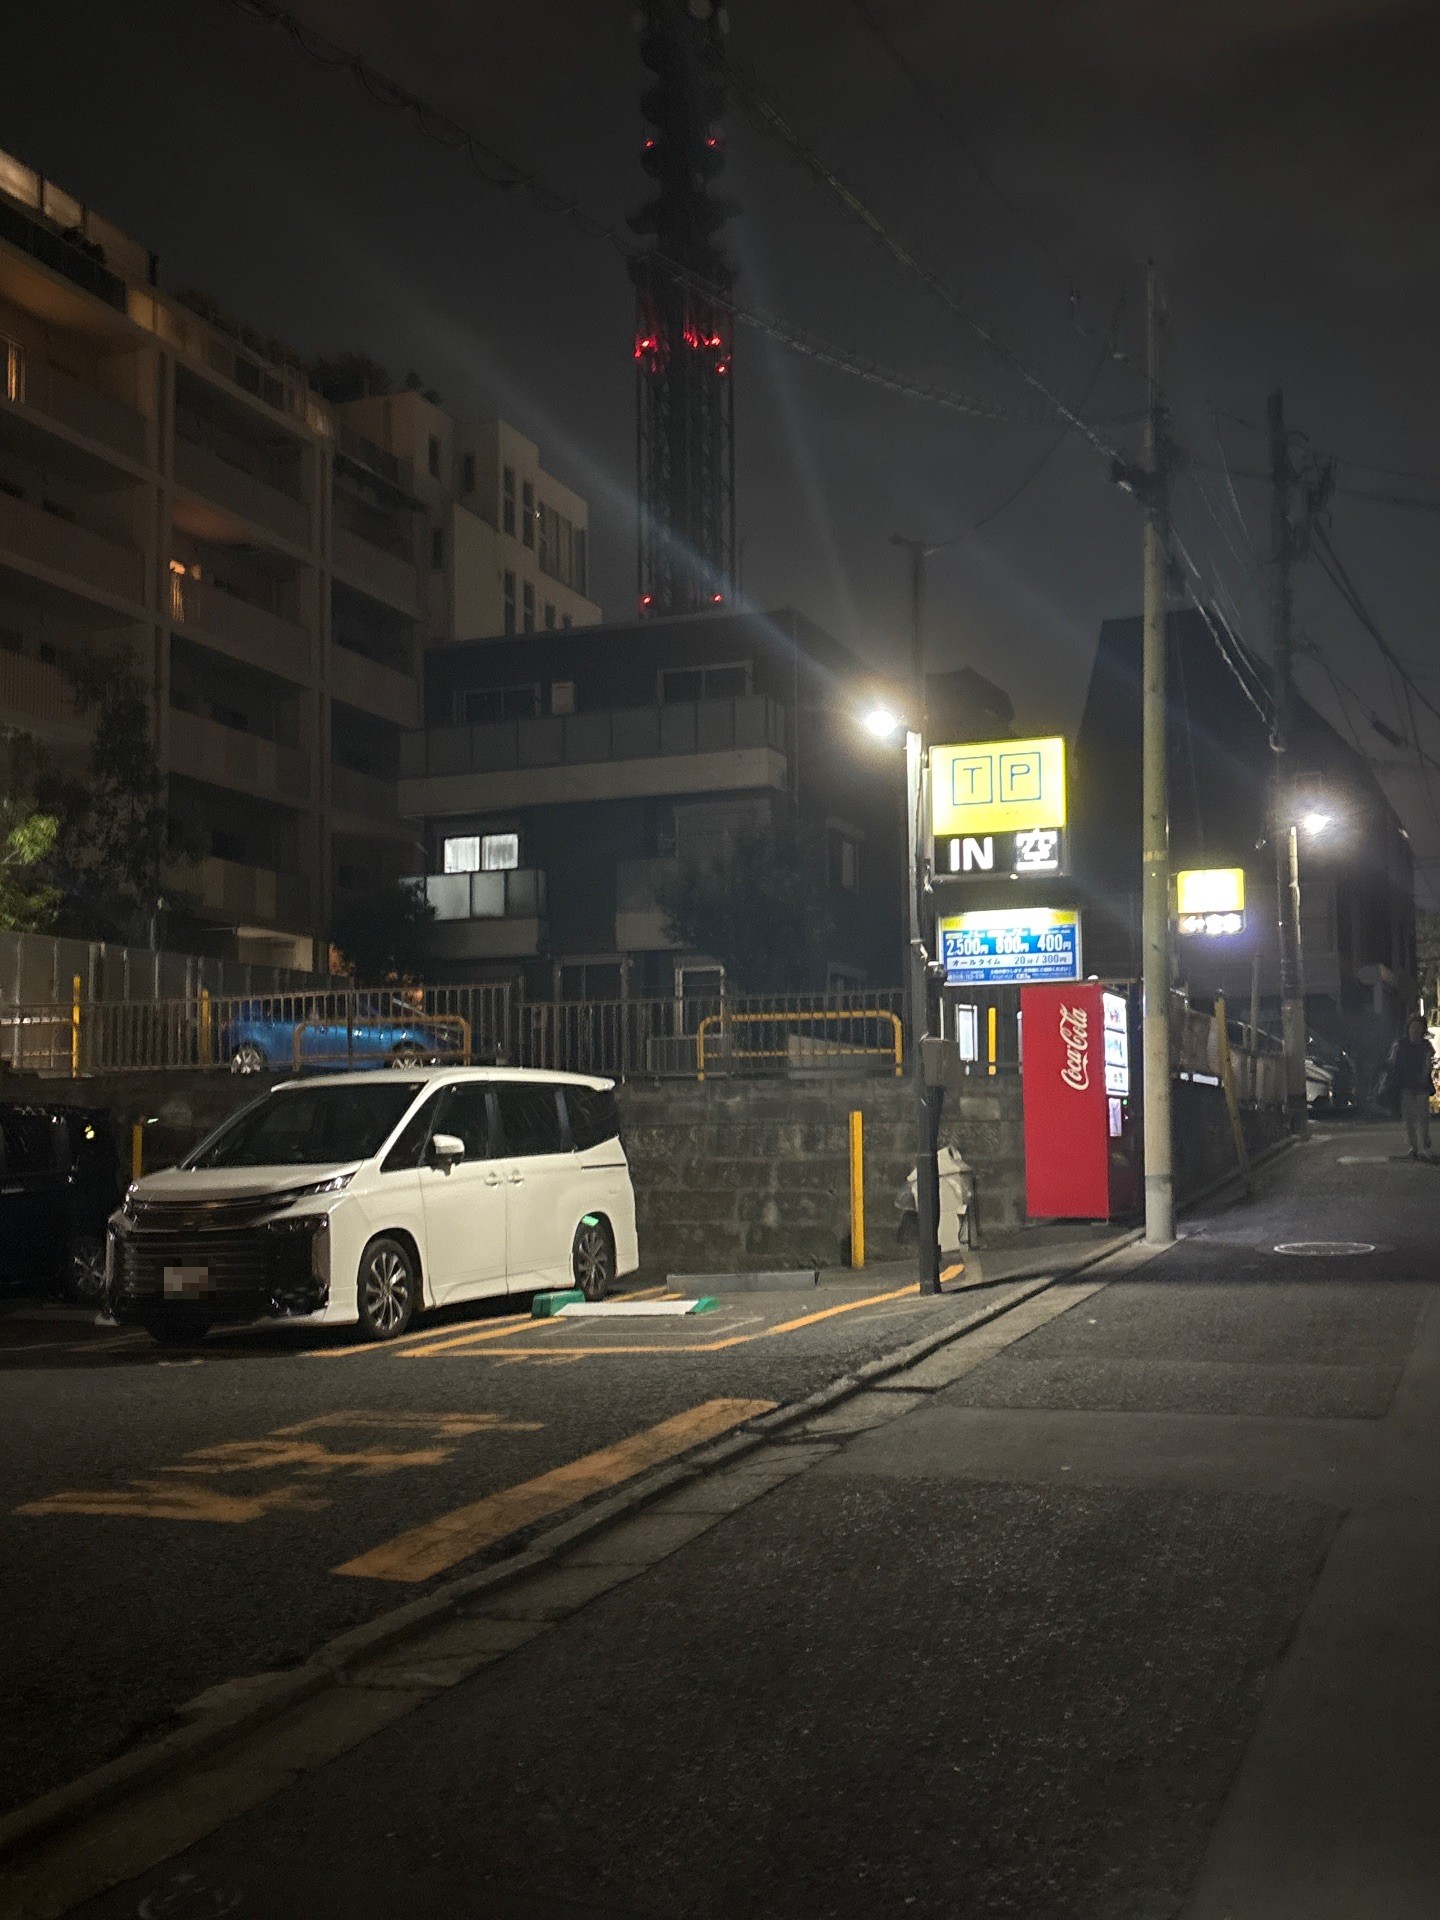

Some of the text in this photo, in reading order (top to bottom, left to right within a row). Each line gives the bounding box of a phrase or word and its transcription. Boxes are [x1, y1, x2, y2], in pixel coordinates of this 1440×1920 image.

[950, 836, 993, 872] IN
[1016, 828, 1058, 871] 空
[1037, 933, 1071, 951] 400円
[951, 958, 1001, 967] オールタイム
